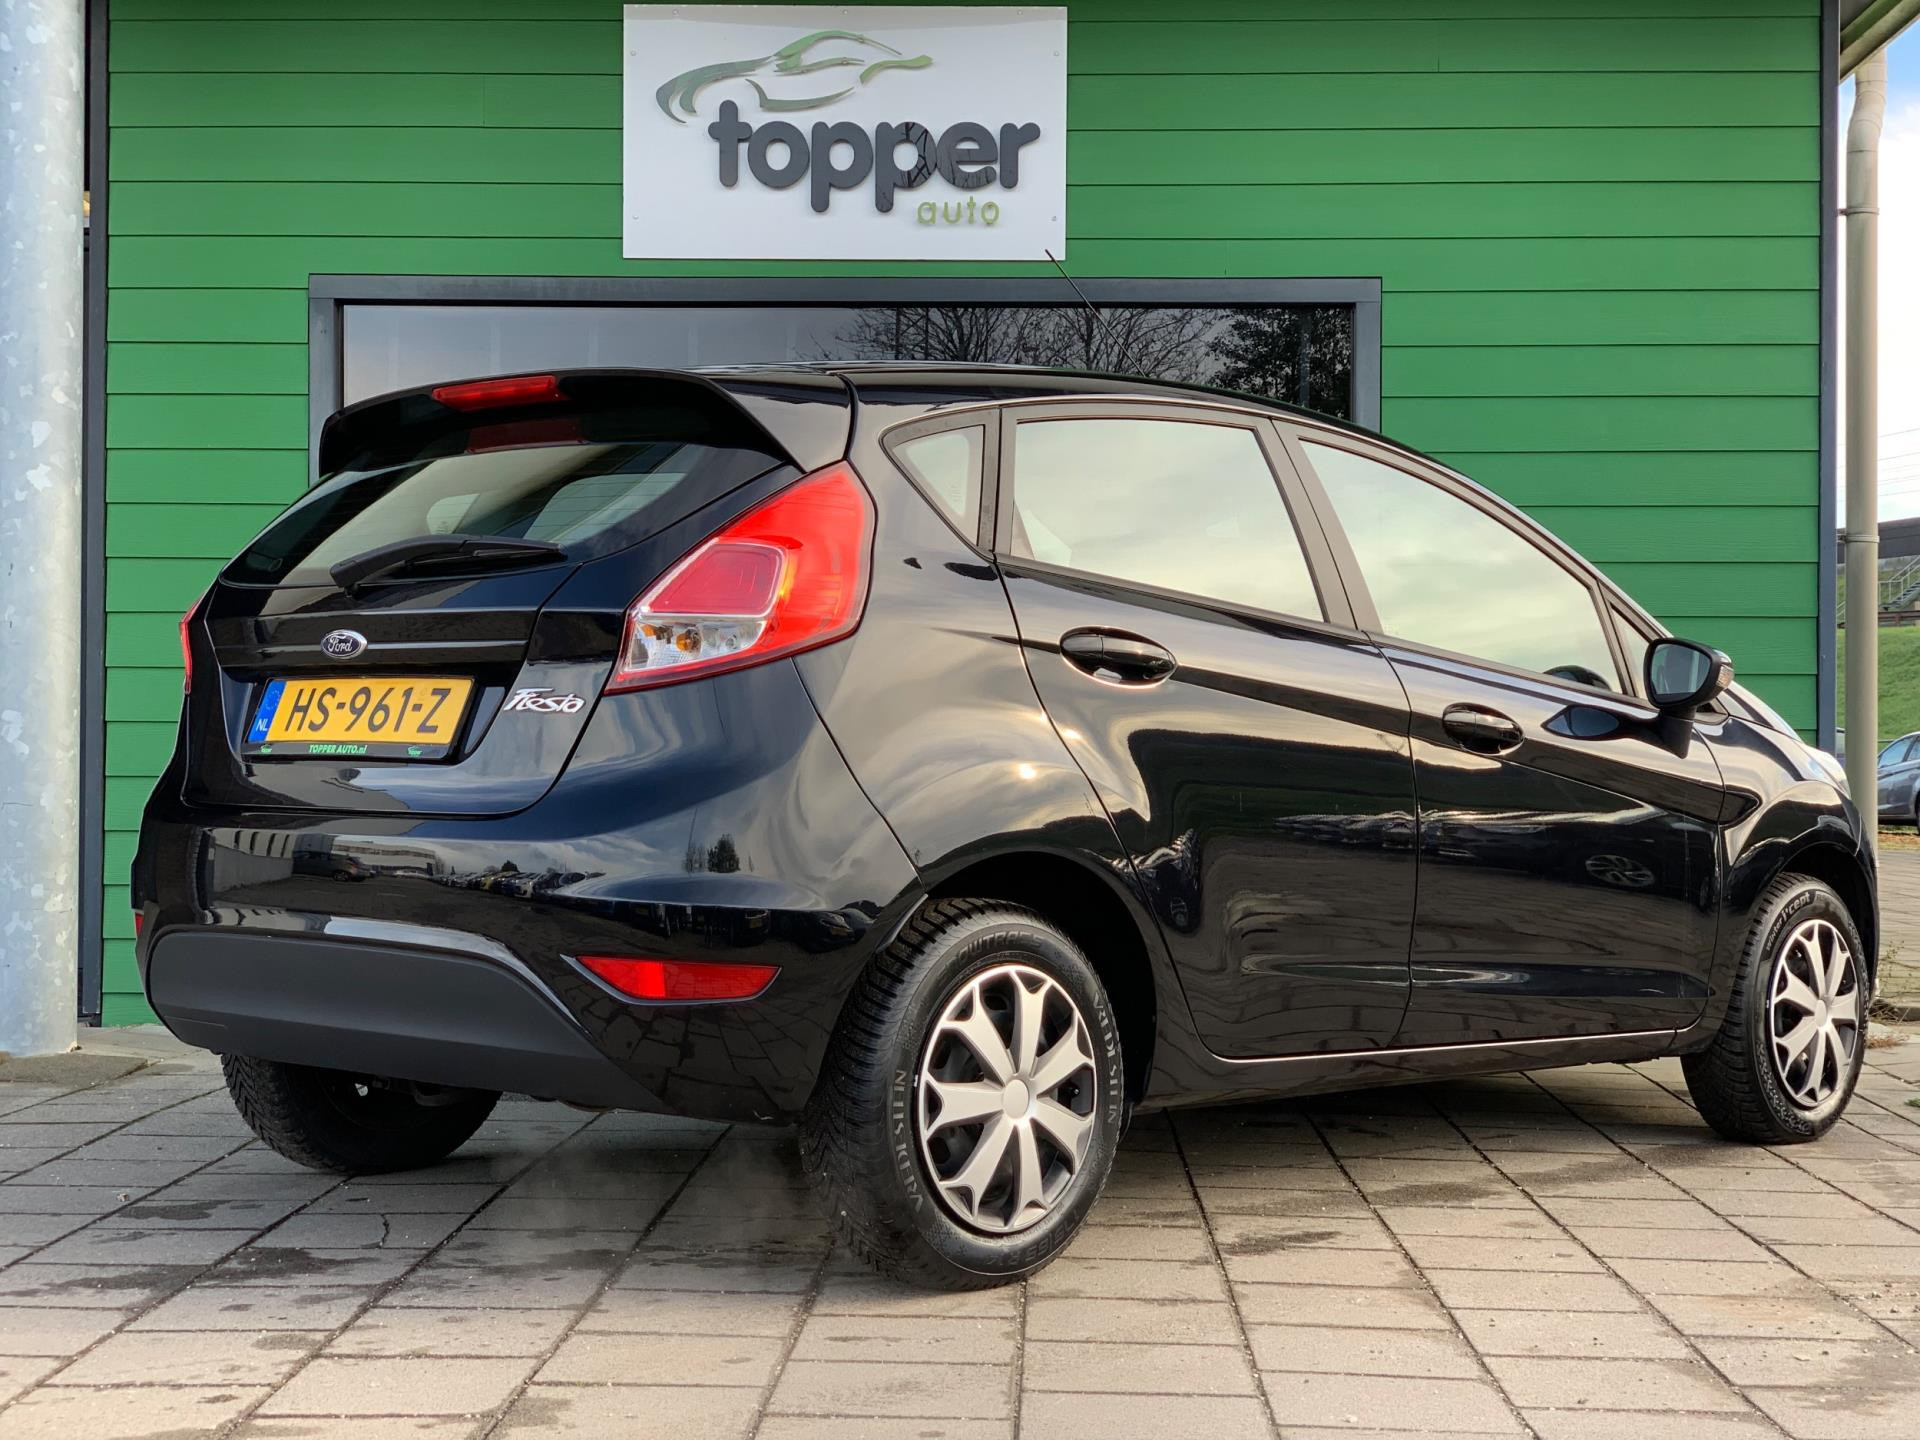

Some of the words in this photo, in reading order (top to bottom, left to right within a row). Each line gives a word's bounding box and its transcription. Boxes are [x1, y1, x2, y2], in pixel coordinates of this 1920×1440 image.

[708, 100, 1041, 213] topper
[917, 197, 1000, 226] auto
[328, 635, 353, 652] Ford
[284, 686, 452, 733] HS-961-Z
[503, 687, 585, 713] Fiesta
[255, 718, 269, 732] NL
[309, 744, 336, 754] TOPPER
[337, 744, 367, 754] AUTO.nl
